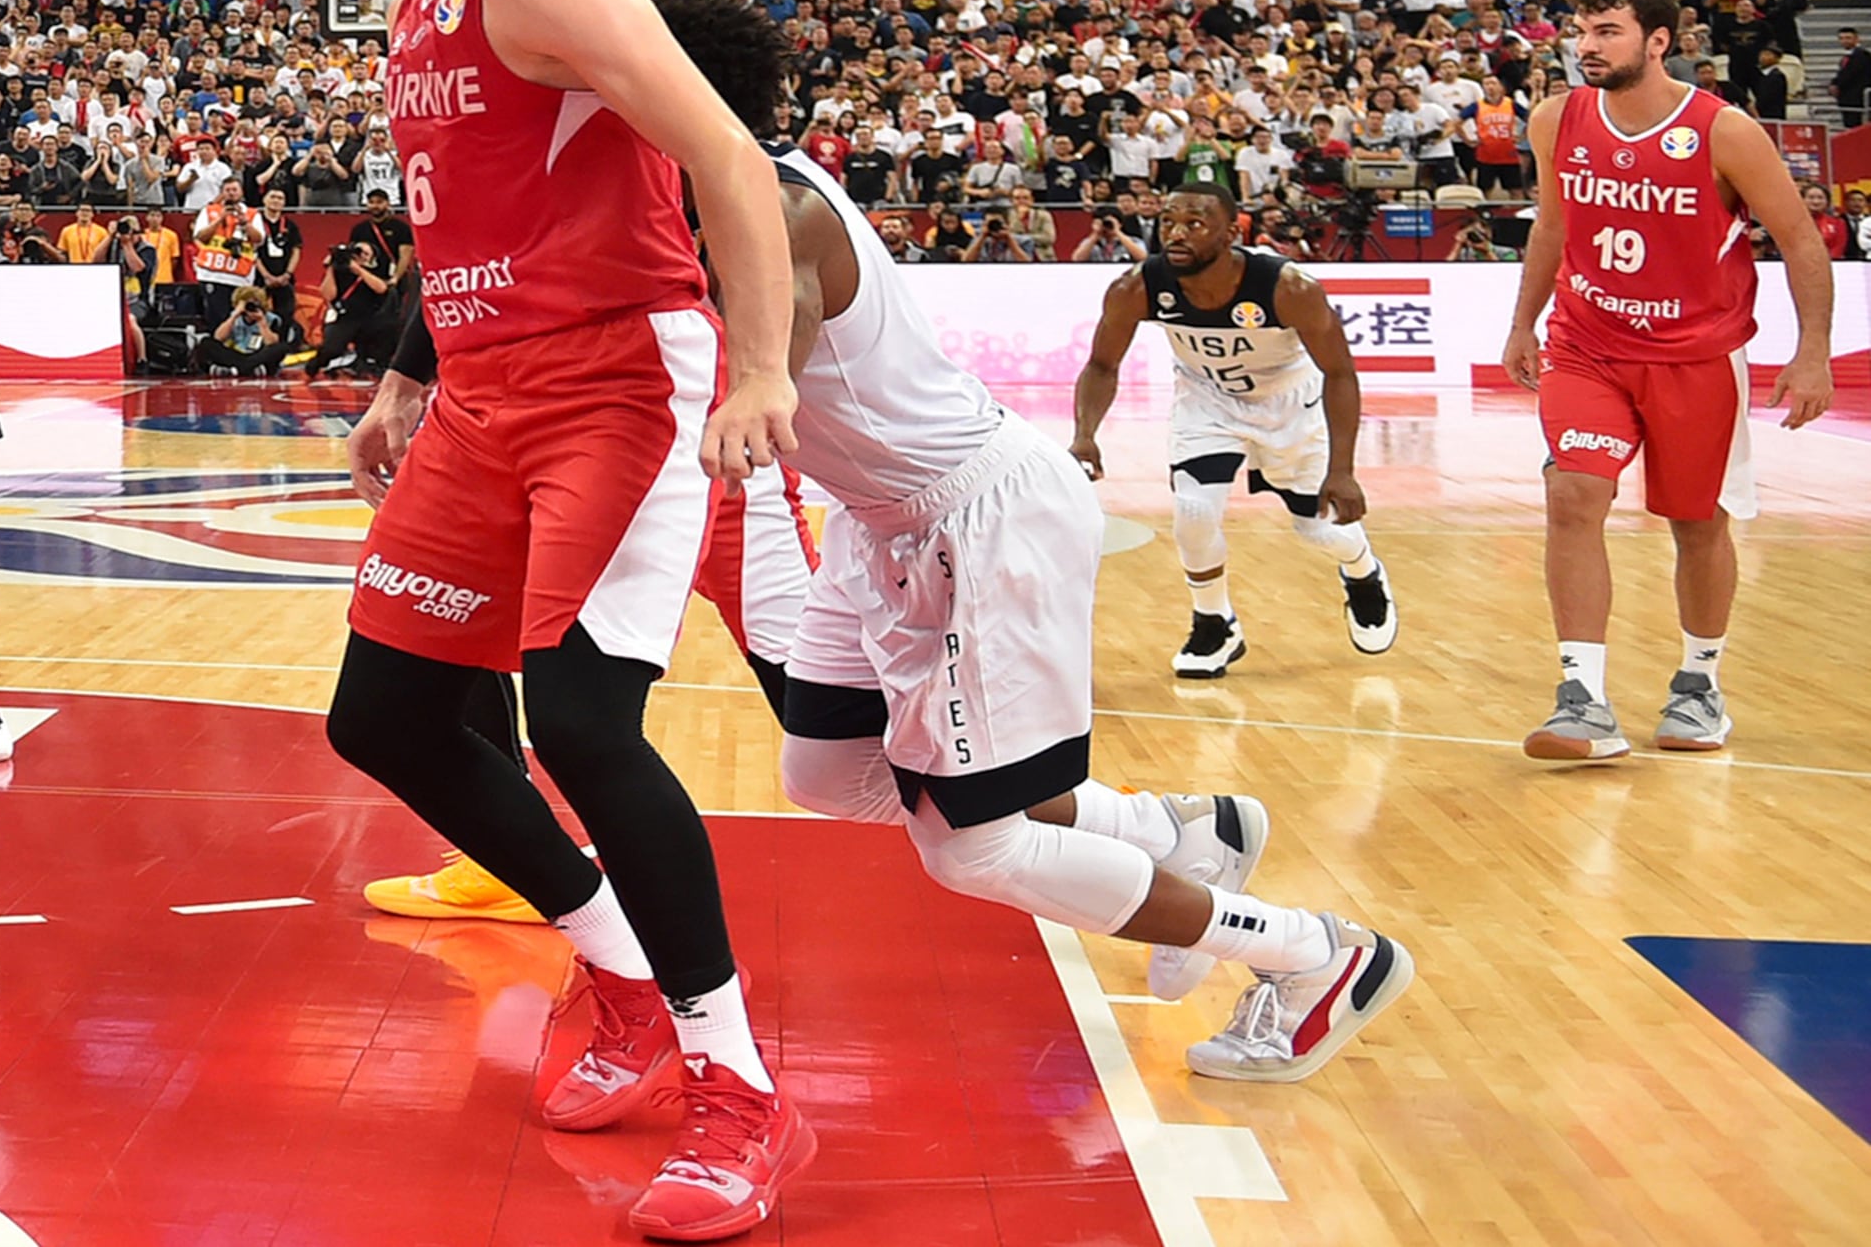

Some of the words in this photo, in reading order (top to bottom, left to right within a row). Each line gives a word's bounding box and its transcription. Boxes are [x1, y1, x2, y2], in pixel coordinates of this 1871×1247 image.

[405, 151, 437, 226] 6
[1559, 169, 1698, 215] TÜRKİYE
[1592, 226, 1646, 274] 19
[427, 295, 500, 328] BBVA
[1584, 286, 1681, 319] Garanti
[1175, 332, 1255, 358] USA
[1201, 363, 1255, 393] 15
[359, 552, 491, 612] Bilyoner
[413, 599, 470, 624] .com
